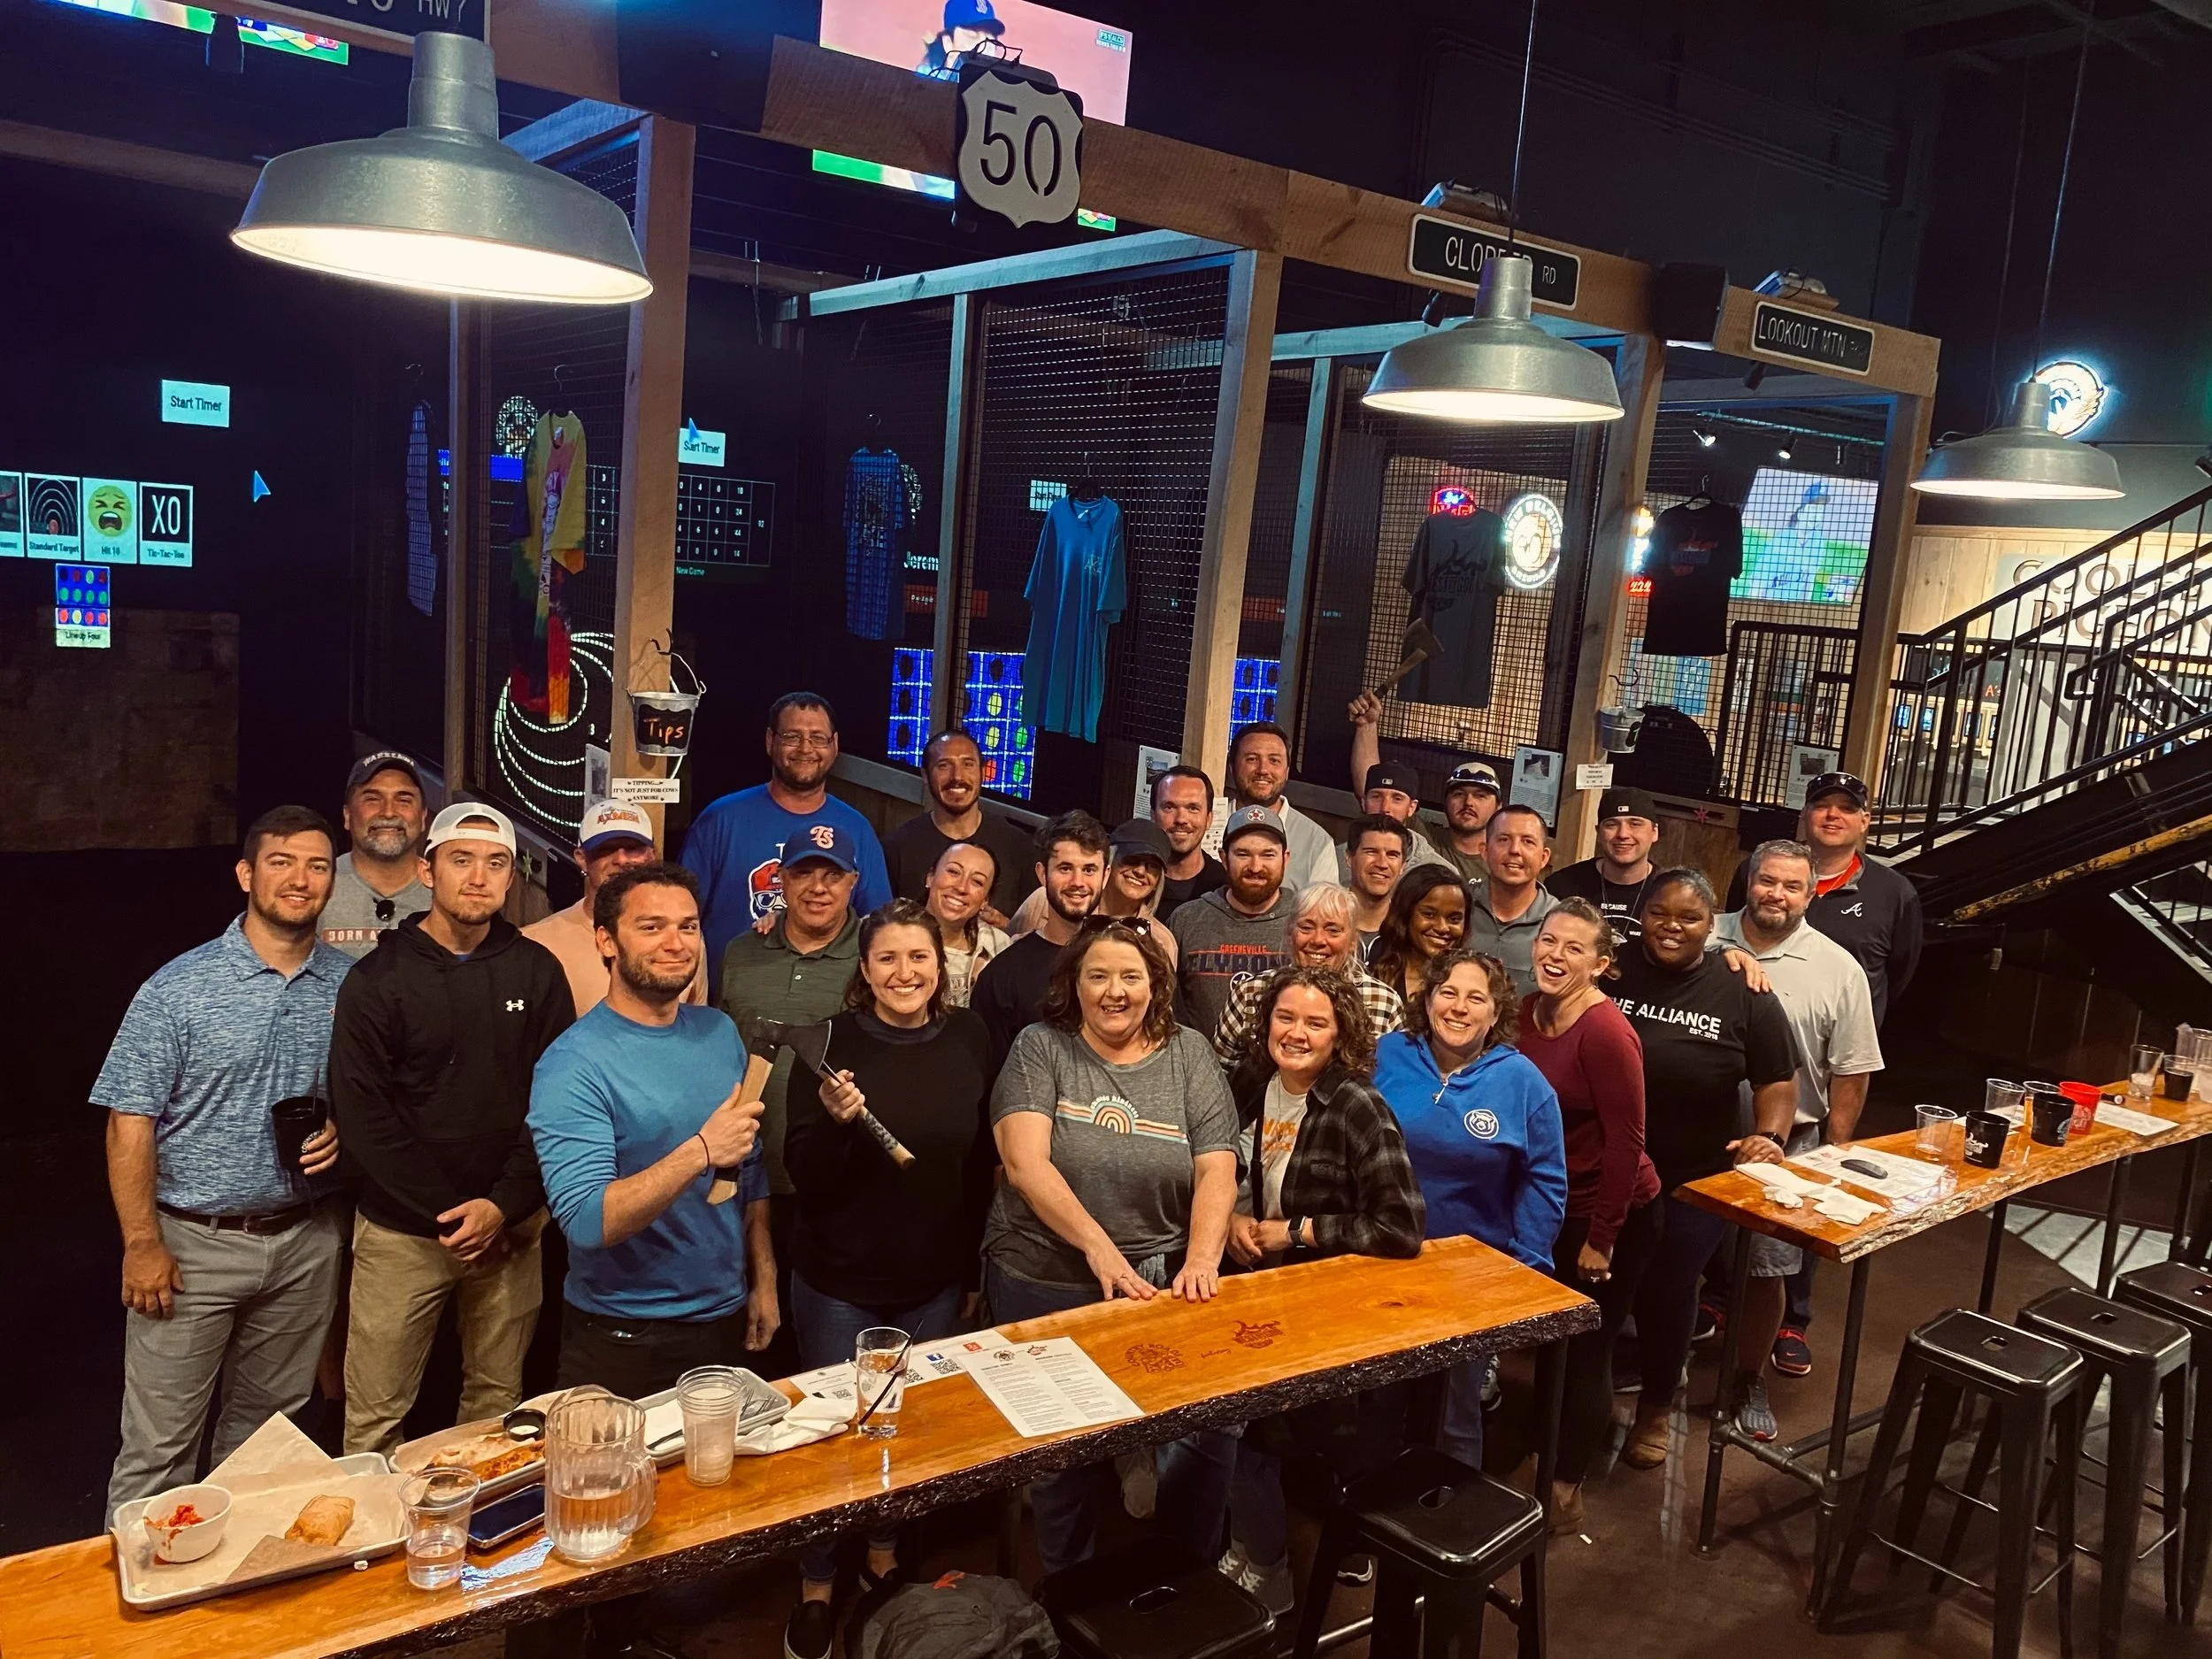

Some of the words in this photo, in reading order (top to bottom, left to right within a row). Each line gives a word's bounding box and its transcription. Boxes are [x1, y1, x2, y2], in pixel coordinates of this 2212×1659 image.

[979, 99, 1062, 196] 50
[1541, 265, 1557, 285] RD
[1758, 314, 1819, 350] LOOKOUT
[171, 396, 193, 409] Start
[196, 397, 222, 411] Timer
[702, 442, 720, 454] Timer
[151, 495, 180, 535] XO
[29, 541, 58, 551] Standard
[58, 542, 80, 554] Target
[688, 566, 705, 575] Game
[643, 718, 685, 744] Tips
[1601, 902, 1628, 911] BECAUSE
[328, 930, 363, 941] BORN
[1611, 997, 1635, 1015] HE
[1635, 1003, 1722, 1034] ALLIANCE
[1688, 1026, 1704, 1036] EST.
